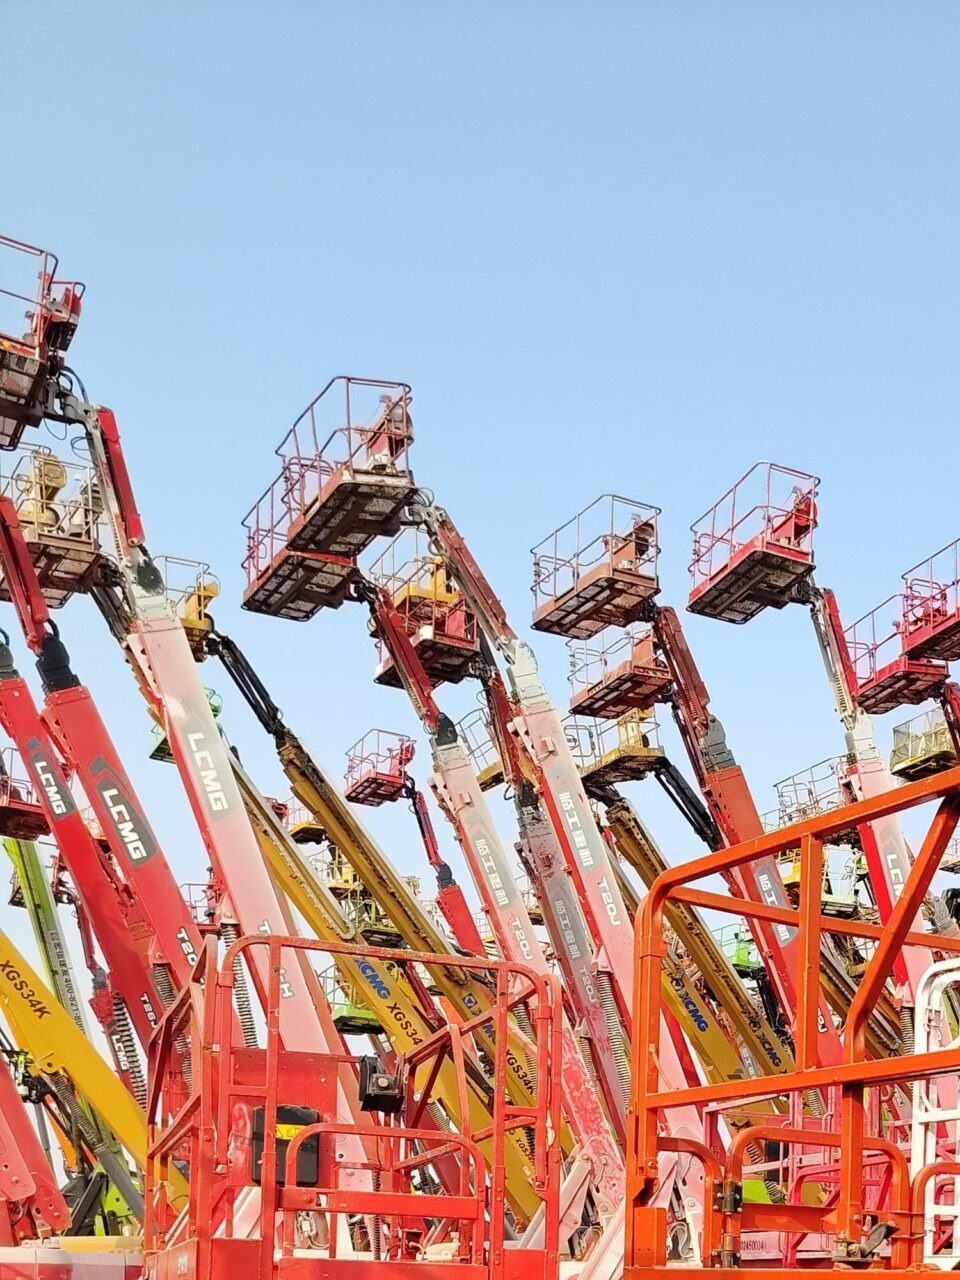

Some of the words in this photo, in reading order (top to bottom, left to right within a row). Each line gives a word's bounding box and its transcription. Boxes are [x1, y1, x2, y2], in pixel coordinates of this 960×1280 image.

[598, 876, 621, 926] T20J
[758, 873, 791, 940] 临工机
[511, 916, 534, 960] T20J
[0, 960, 52, 1020] XGS34K
[387, 1001, 424, 1046] XGS34
